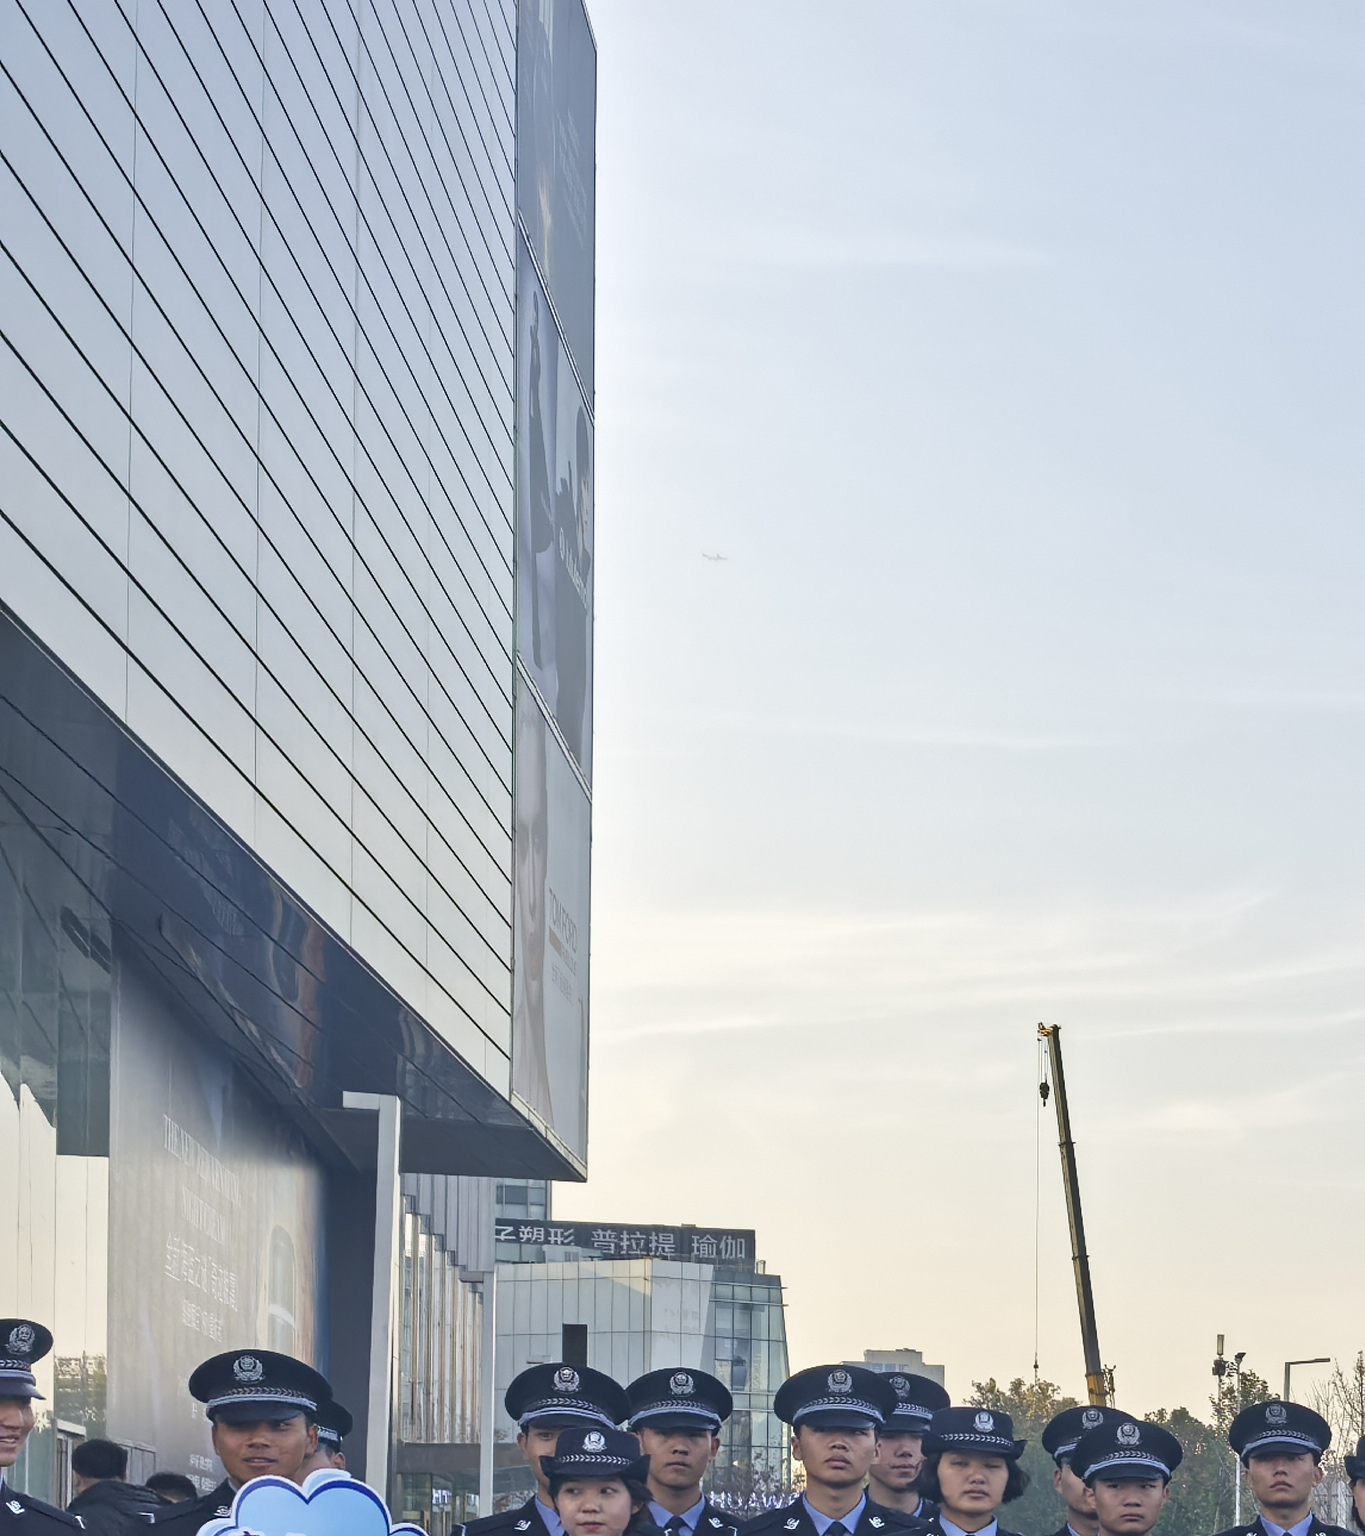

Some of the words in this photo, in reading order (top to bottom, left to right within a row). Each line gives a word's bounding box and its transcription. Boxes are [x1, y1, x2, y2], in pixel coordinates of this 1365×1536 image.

[591, 1229, 675, 1256] 普拉提
[692, 1234, 746, 1260] 瑜伽
